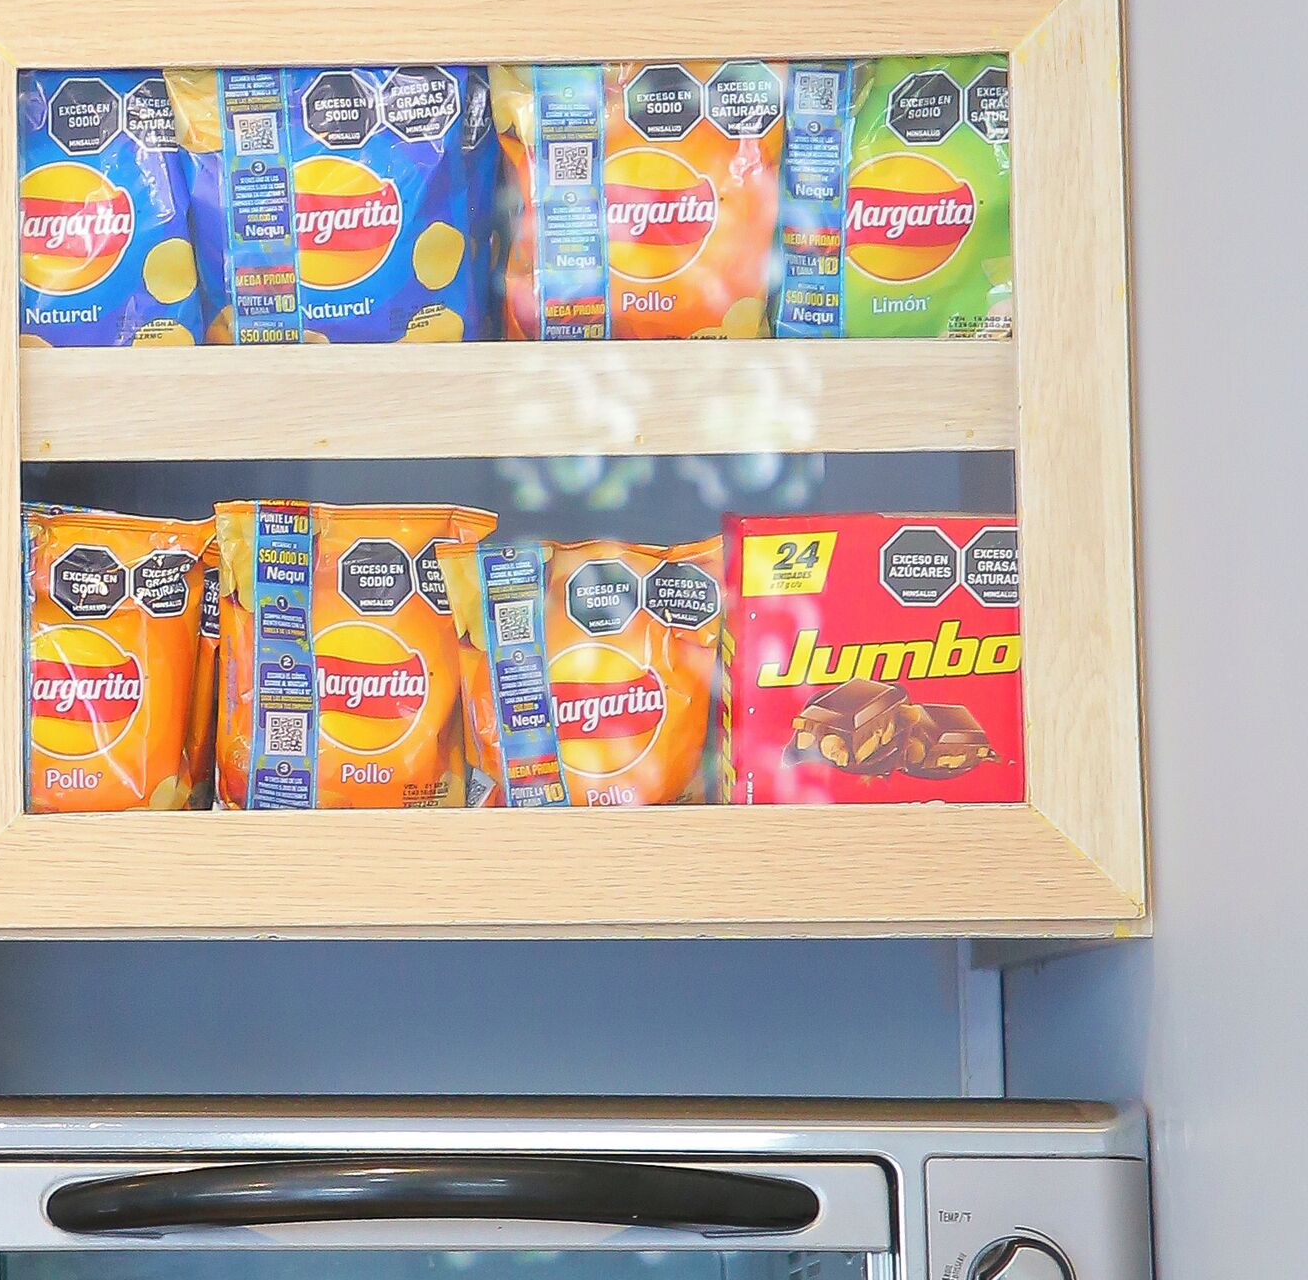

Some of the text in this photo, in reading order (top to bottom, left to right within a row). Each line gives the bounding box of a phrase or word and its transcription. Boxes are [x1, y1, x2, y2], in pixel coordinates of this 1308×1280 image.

[391, 81, 445, 96] EXCESO EN
[718, 81, 771, 92] EXCESO EN
[314, 98, 366, 110] EXCESO EN
[397, 93, 443, 108] GRASAS
[637, 92, 691, 102] EXCESO EN
[722, 93, 768, 104] GRASAS
[388, 104, 454, 122] SATURADAS
[646, 102, 682, 113] SODIO
[712, 105, 778, 116] SATURADAS
[325, 111, 359, 121] SODIO
[796, 183, 834, 197] Nequi
[295, 200, 399, 244] argarita
[605, 196, 714, 235] argarita
[245, 225, 284, 237] Nequi
[622, 292, 673, 311] Pollo
[873, 294, 927, 312] Limón
[26, 305, 98, 324] Natural
[793, 311, 834, 324] Nequi
[241, 329, 299, 342] $50.000 EN
[259, 550, 296, 565] $50.000
[773, 540, 820, 570] 24
[892, 554, 948, 565] EXCESO EN
[351, 565, 403, 576] EXCESO EN
[889, 563, 951, 577] AZÚCARES
[978, 561, 1017, 571] GRASA
[267, 567, 305, 582] Nequi
[360, 576, 394, 587] SODIO
[968, 573, 1018, 584] SATURAD
[577, 583, 630, 597] EXCESO EN
[587, 595, 620, 608] SODIO
[649, 599, 715, 613] SATURADAS
[757, 620, 1020, 688] Jumbo
[32, 673, 140, 712] argarita
[47, 770, 98, 789] Pollo
[342, 764, 390, 783] Pollo
[587, 787, 633, 806] Pollo
